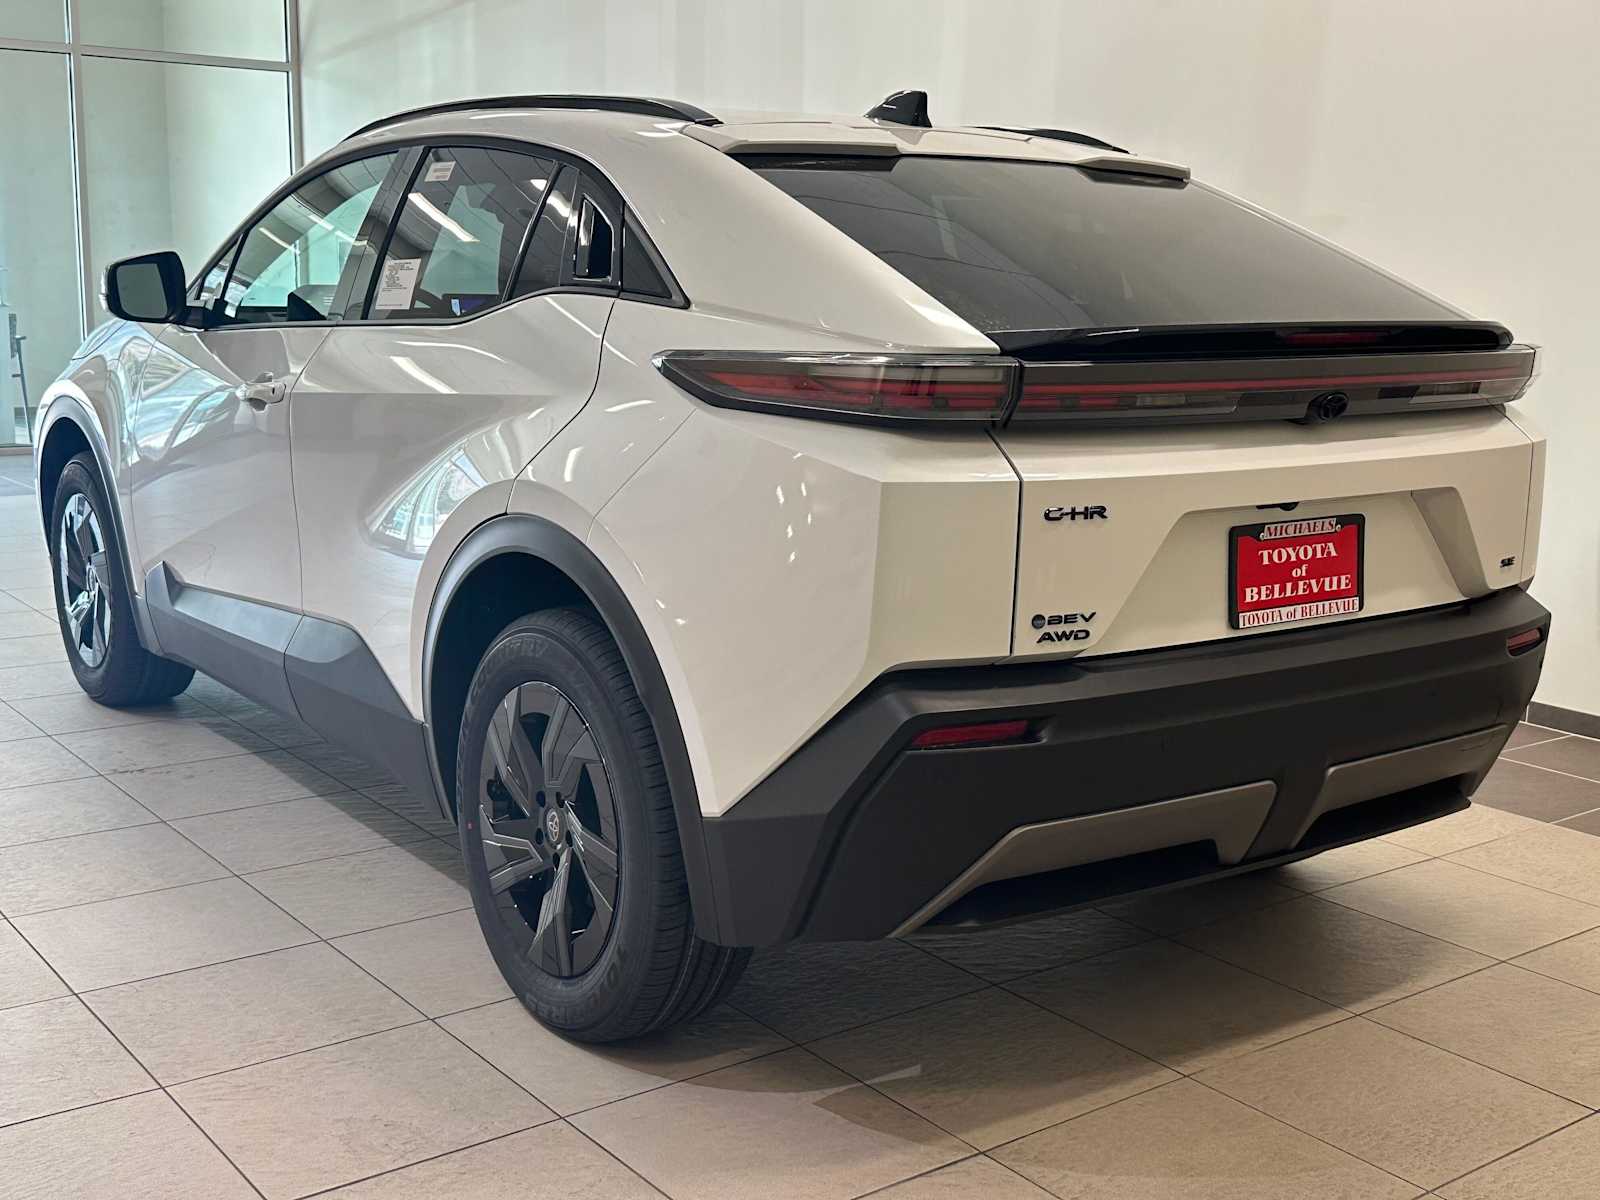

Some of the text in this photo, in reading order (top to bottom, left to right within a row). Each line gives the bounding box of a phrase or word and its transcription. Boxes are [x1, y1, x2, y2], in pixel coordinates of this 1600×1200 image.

[1265, 519, 1335, 539] MICHAELS
[1258, 542, 1338, 565] TOYOTA
[1500, 556, 1515, 568] SE
[1292, 564, 1308, 578] of
[1244, 575, 1352, 603] BELLEVUE
[1047, 612, 1097, 626] BEV
[1241, 599, 1358, 627] TOYOTA of BELLEVUE
[1036, 629, 1090, 643] AWD
